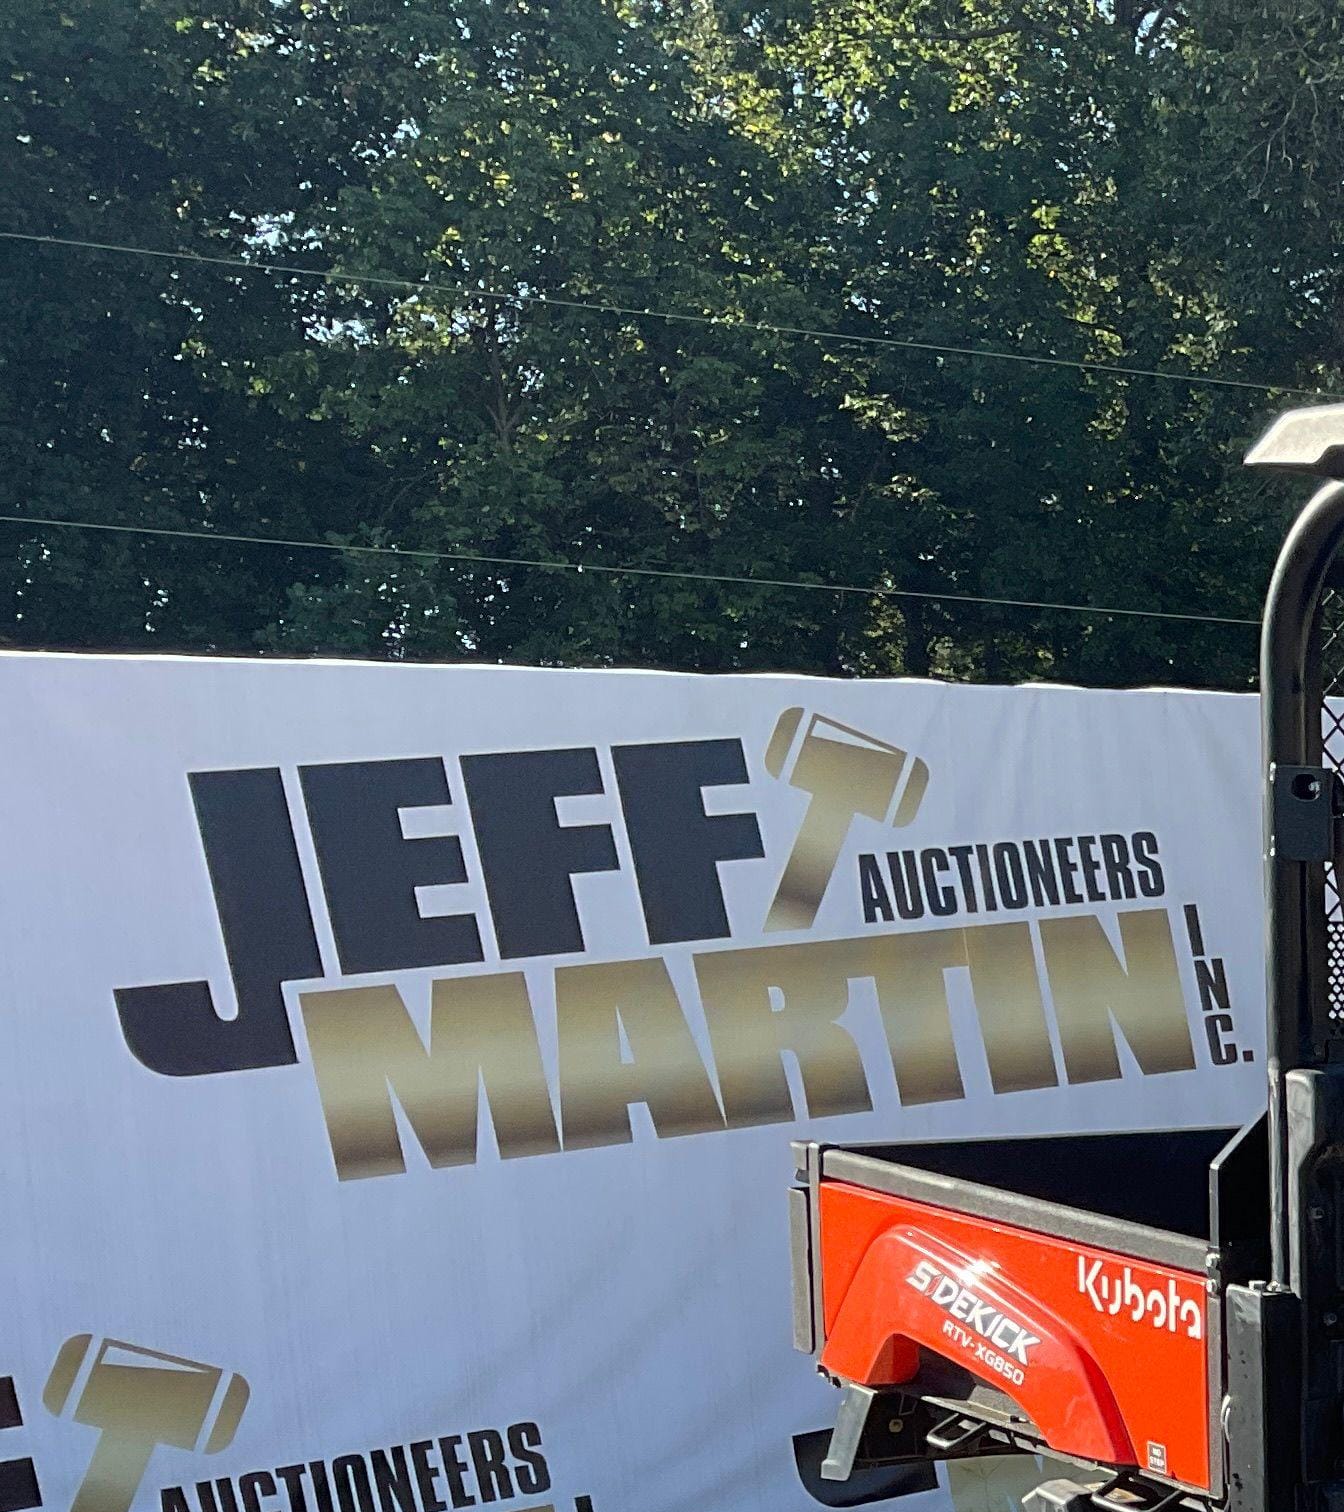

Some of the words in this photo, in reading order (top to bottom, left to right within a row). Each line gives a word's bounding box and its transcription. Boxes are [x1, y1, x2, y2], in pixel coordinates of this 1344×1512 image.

[114, 738, 764, 1077] JEFF
[860, 831, 1164, 923] AUCTIONEERS
[300, 910, 1197, 1182] MARTIN
[906, 1261, 1041, 1366] SIDEKICK
[1076, 1256, 1202, 1340] Kubota
[942, 1319, 1025, 1386] RTV-XG850
